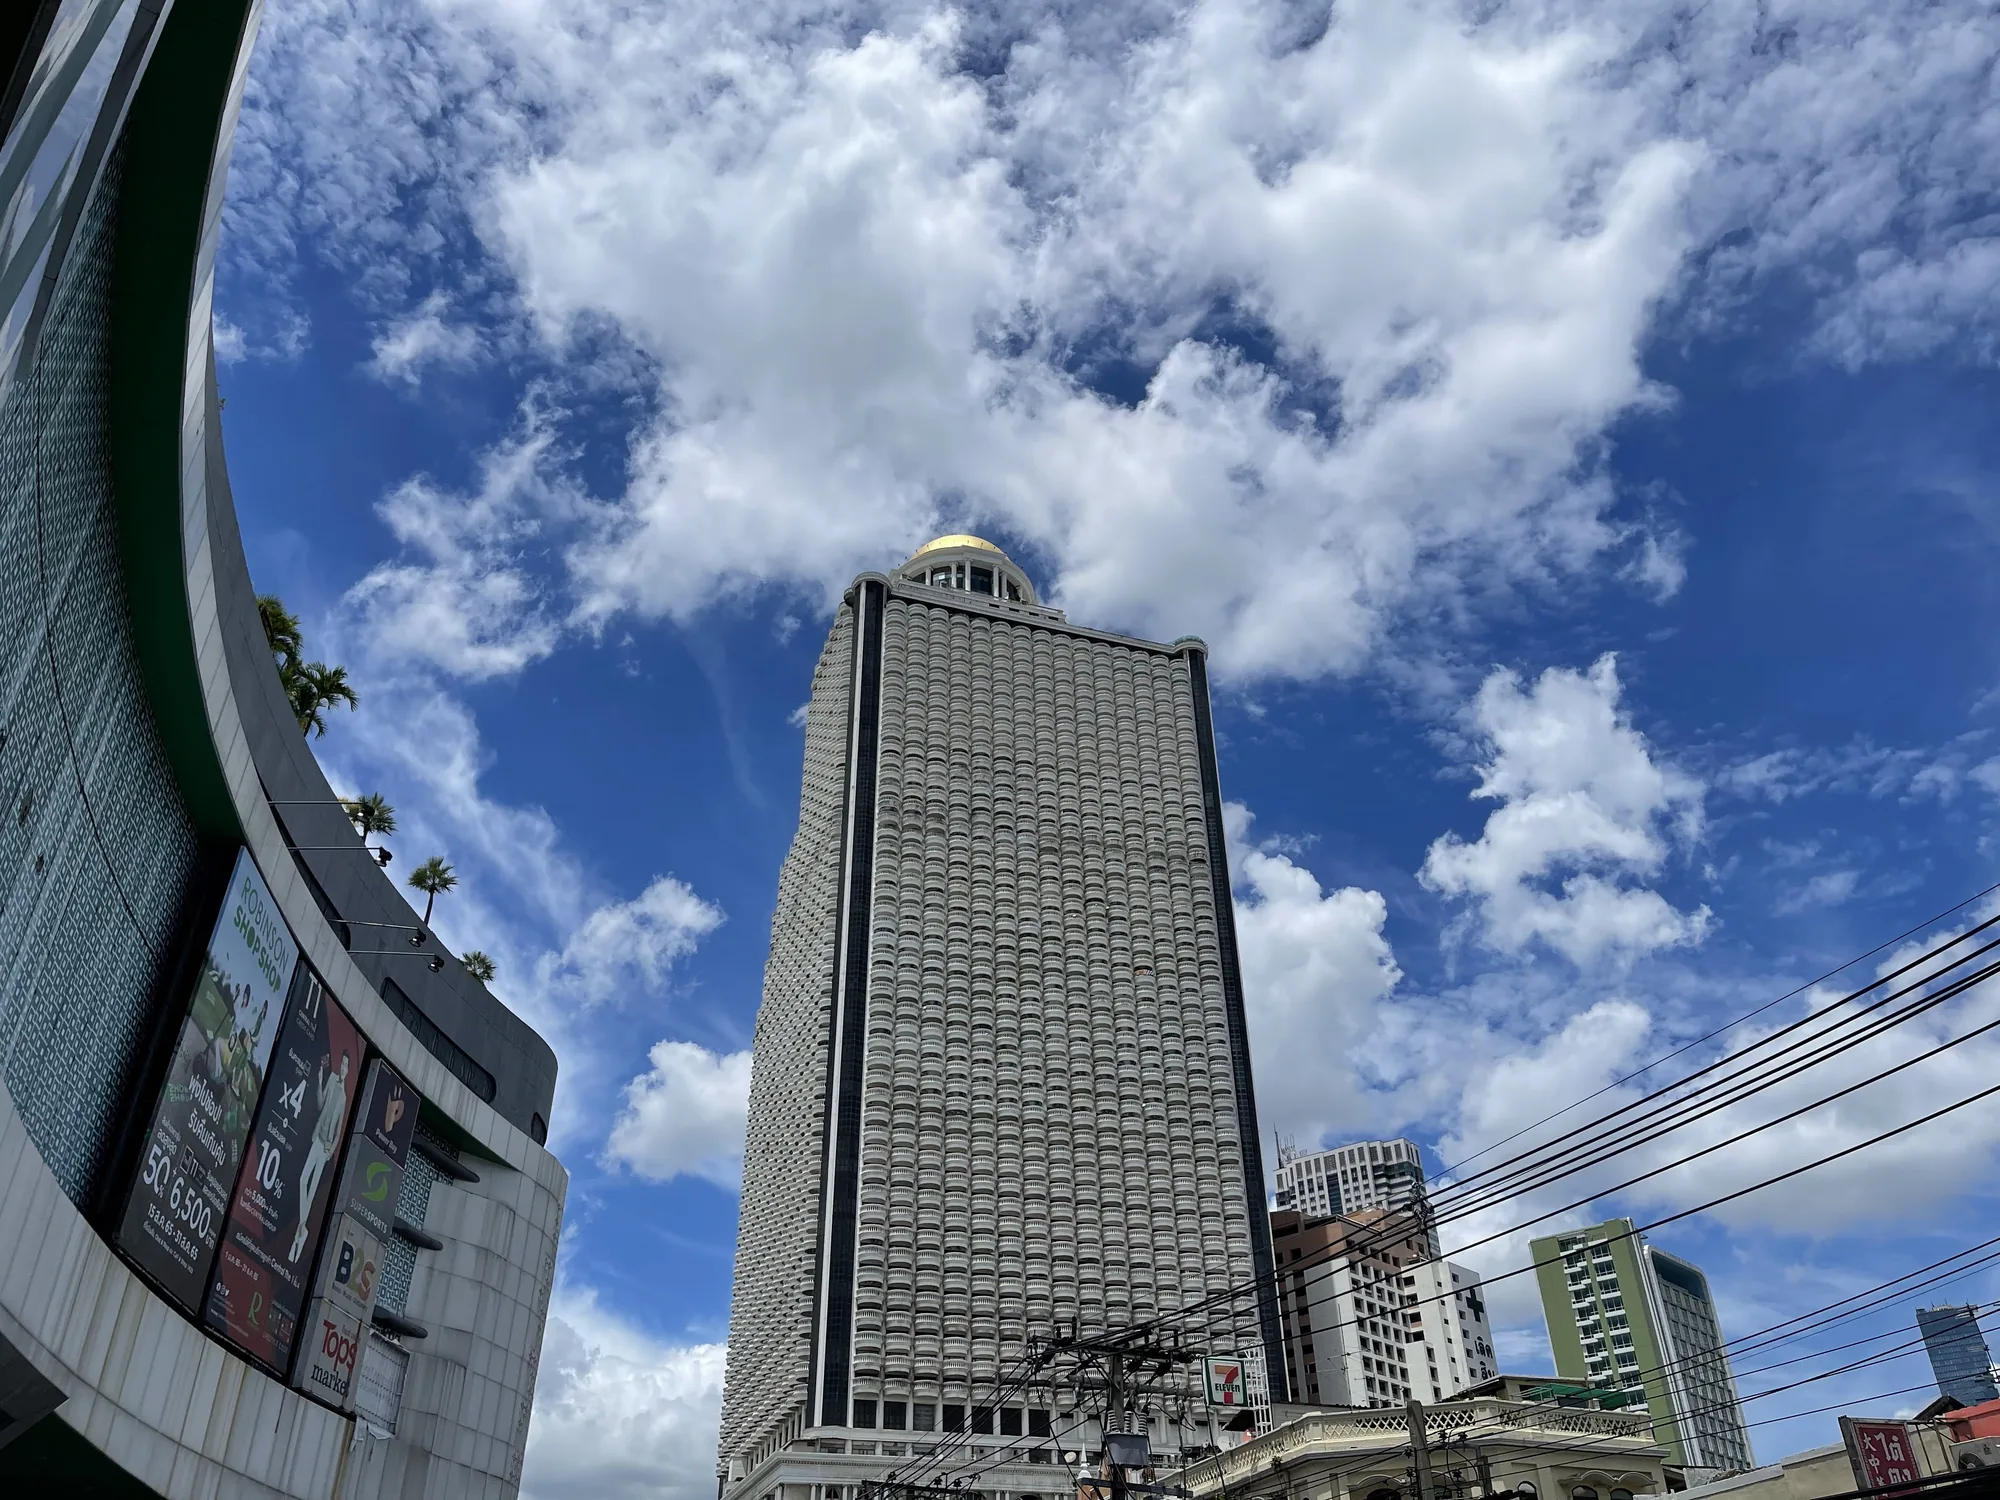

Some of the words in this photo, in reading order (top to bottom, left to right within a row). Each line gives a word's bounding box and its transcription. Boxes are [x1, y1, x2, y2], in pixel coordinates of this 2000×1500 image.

[234, 905, 281, 993] SHOPSHOP
[241, 875, 289, 974] ROBINSON
[255, 1139, 284, 1199] 10%
[375, 1127, 389, 1146] Power
[387, 1139, 398, 1155] Buy
[169, 1176, 211, 1240] 6,500
[350, 1197, 388, 1235] SUPERSPORTS
[335, 1240, 376, 1301] B2S
[322, 1319, 358, 1375] Tops
[311, 1364, 351, 1398] marke
[1214, 1365, 1239, 1404] 7
